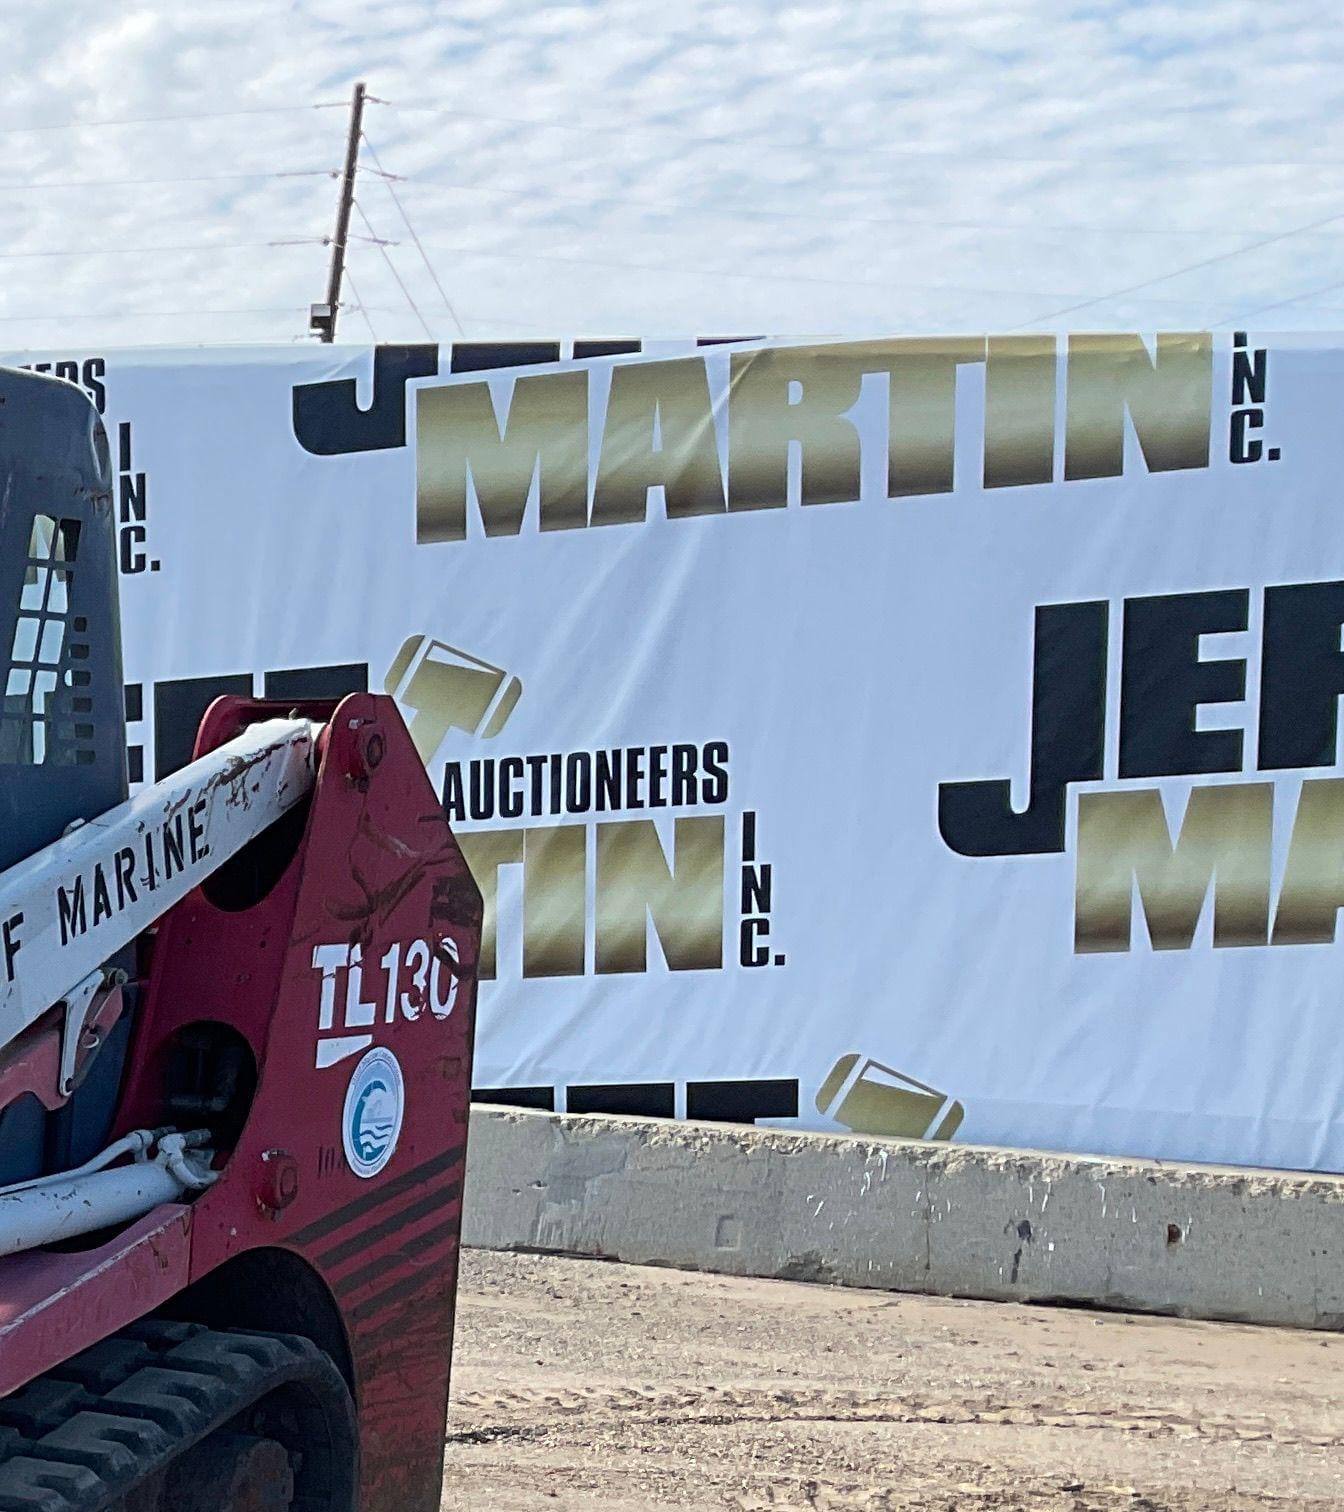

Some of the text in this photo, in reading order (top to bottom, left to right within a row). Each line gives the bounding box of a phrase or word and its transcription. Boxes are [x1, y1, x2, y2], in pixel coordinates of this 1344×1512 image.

[119, 422, 160, 574] INC.
[416, 333, 1214, 545] MARTIN
[442, 742, 729, 821] AUCTIONEERS
[57, 799, 211, 947] MARINE
[740, 812, 786, 967] INC.
